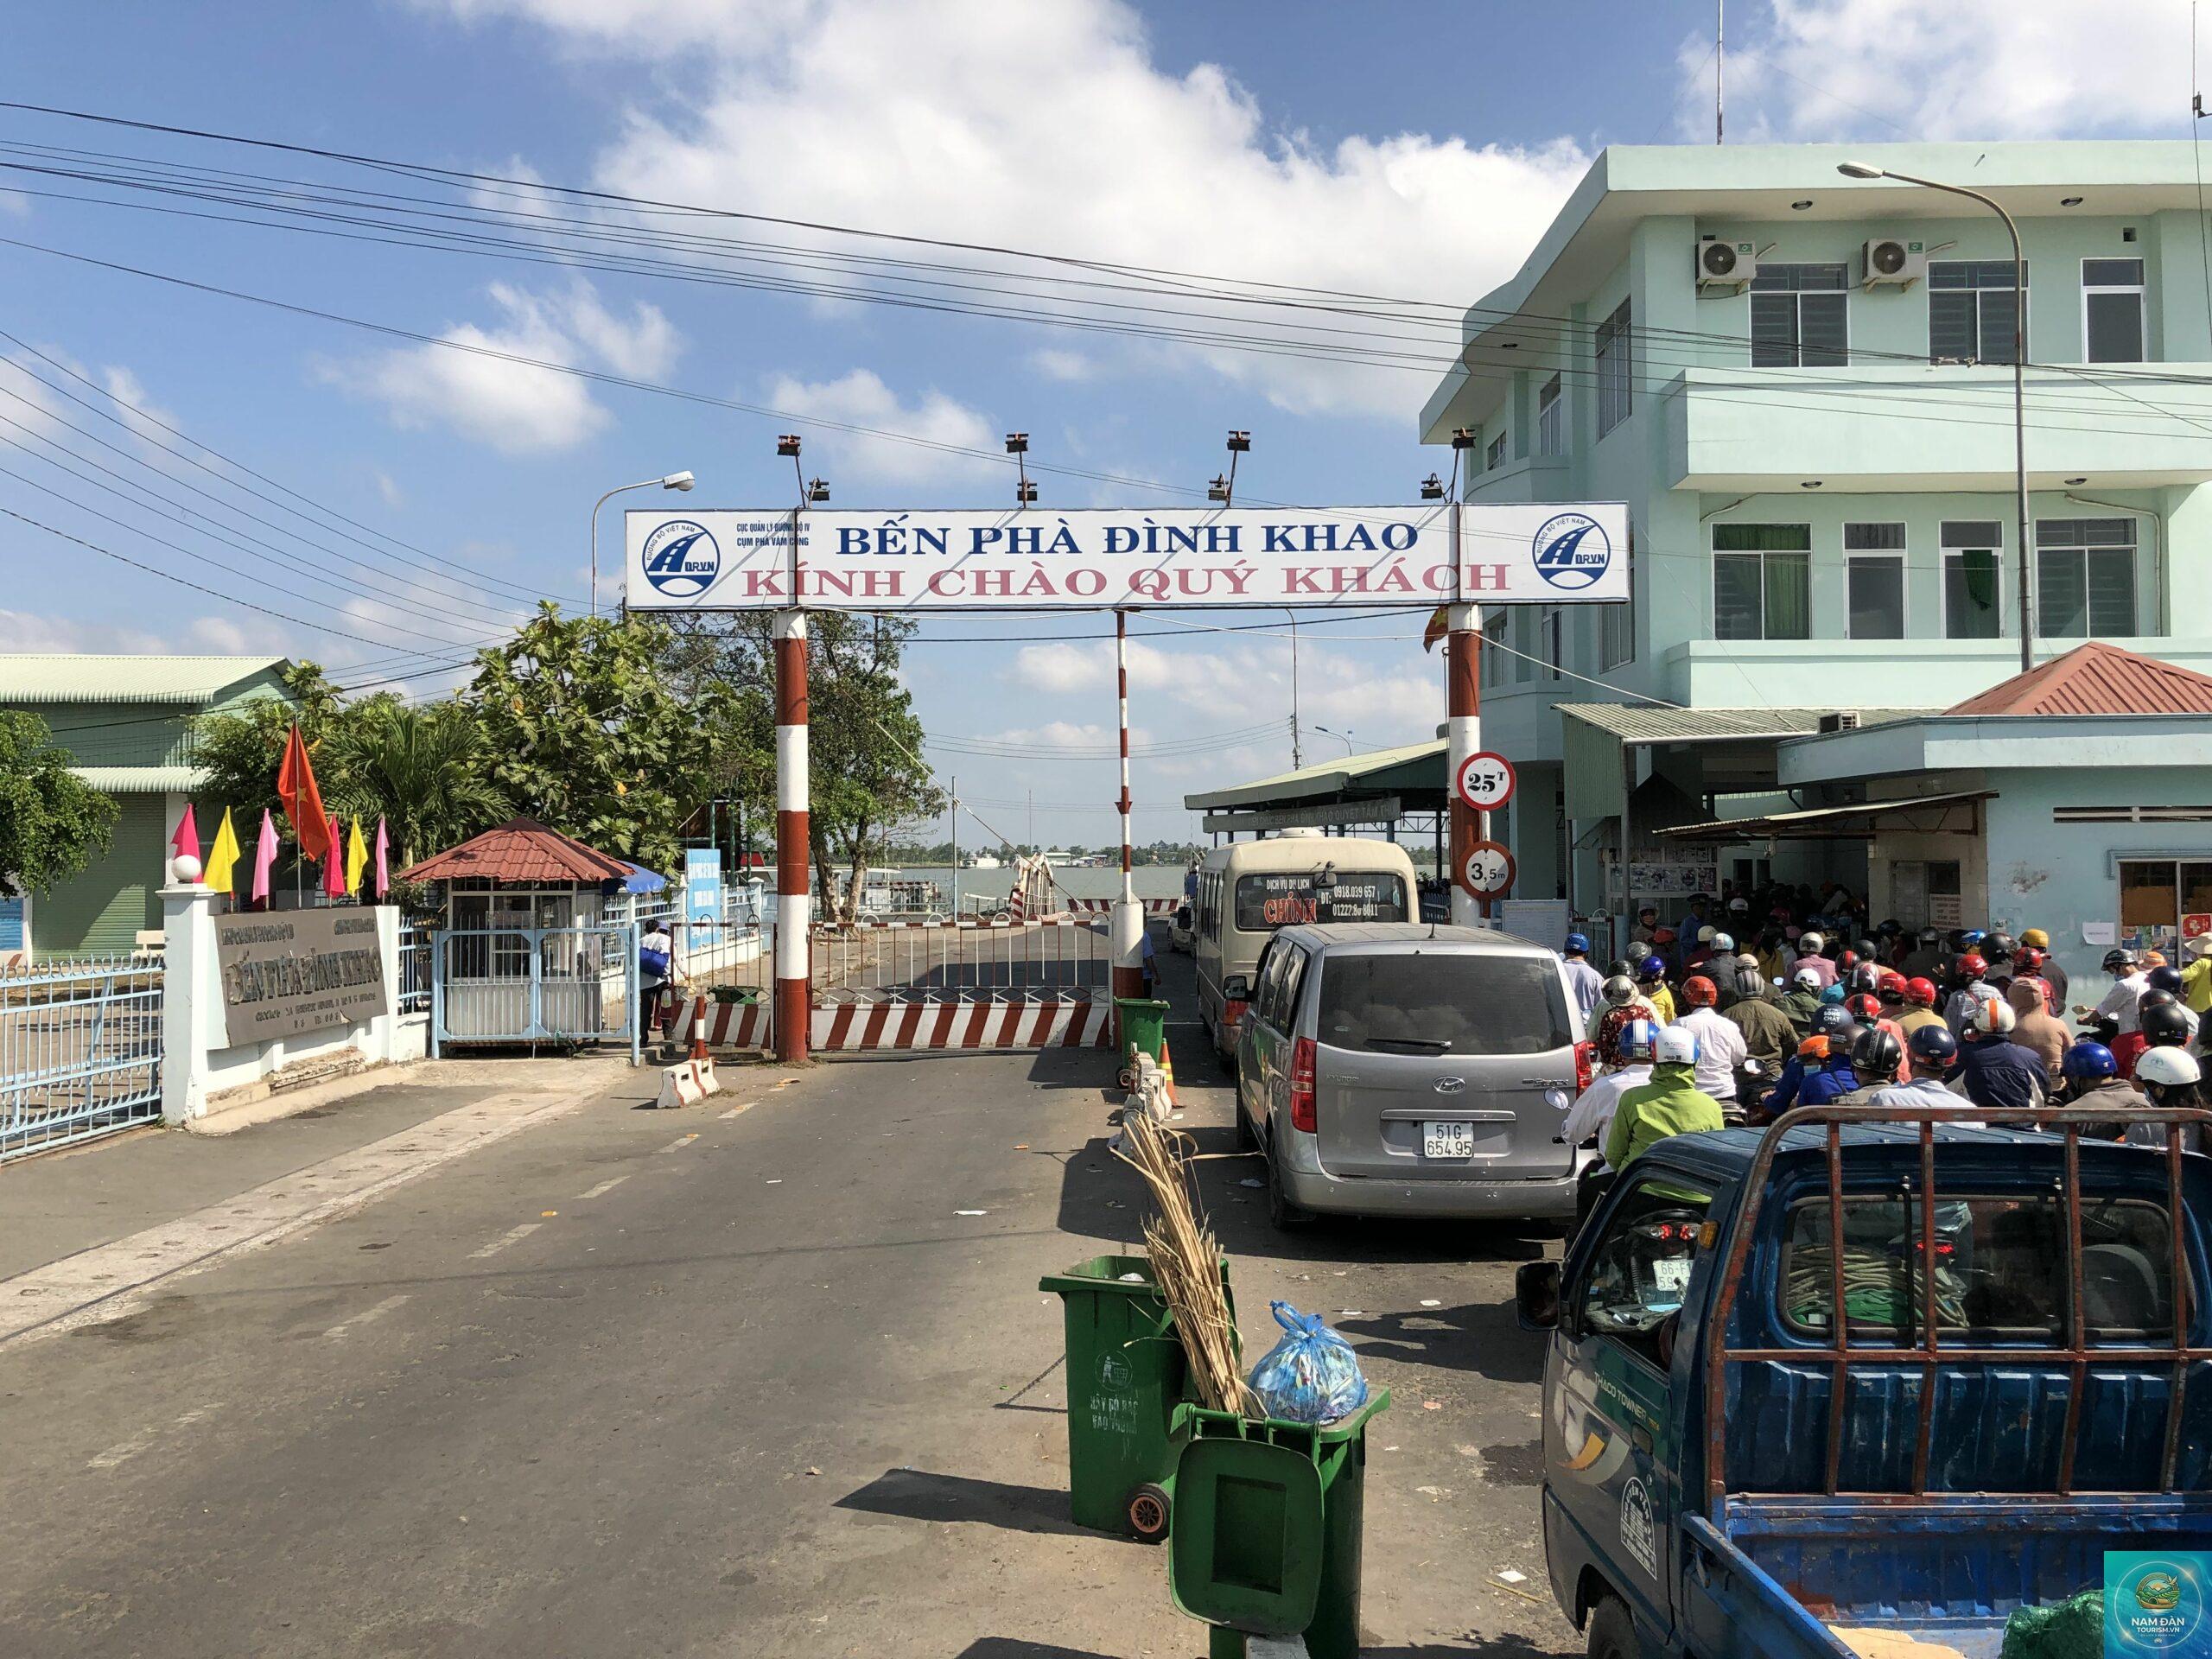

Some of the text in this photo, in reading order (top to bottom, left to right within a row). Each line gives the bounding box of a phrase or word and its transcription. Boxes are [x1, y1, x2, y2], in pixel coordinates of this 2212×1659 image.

[804, 523, 810, 532] IV
[836, 514, 1419, 555] BẾN PHÀ ĐÌNH KHAO
[736, 537, 753, 549] CỤM
[1575, 554, 1605, 564] DRVN
[684, 562, 715, 572] DRVN
[742, 556, 1512, 601] KÍNH CHÀO QUÝ KHÁCH
[1266, 879, 1279, 892] DỊCH
[1281, 879, 1287, 892] VỤ
[1297, 878, 1310, 892] LỊCH
[1363, 885, 1376, 898] 657
[1435, 1124, 1462, 1140] 51G
[1427, 1141, 1472, 1156] 654.95
[1594, 1371, 1647, 1423] THACO TOWNER
